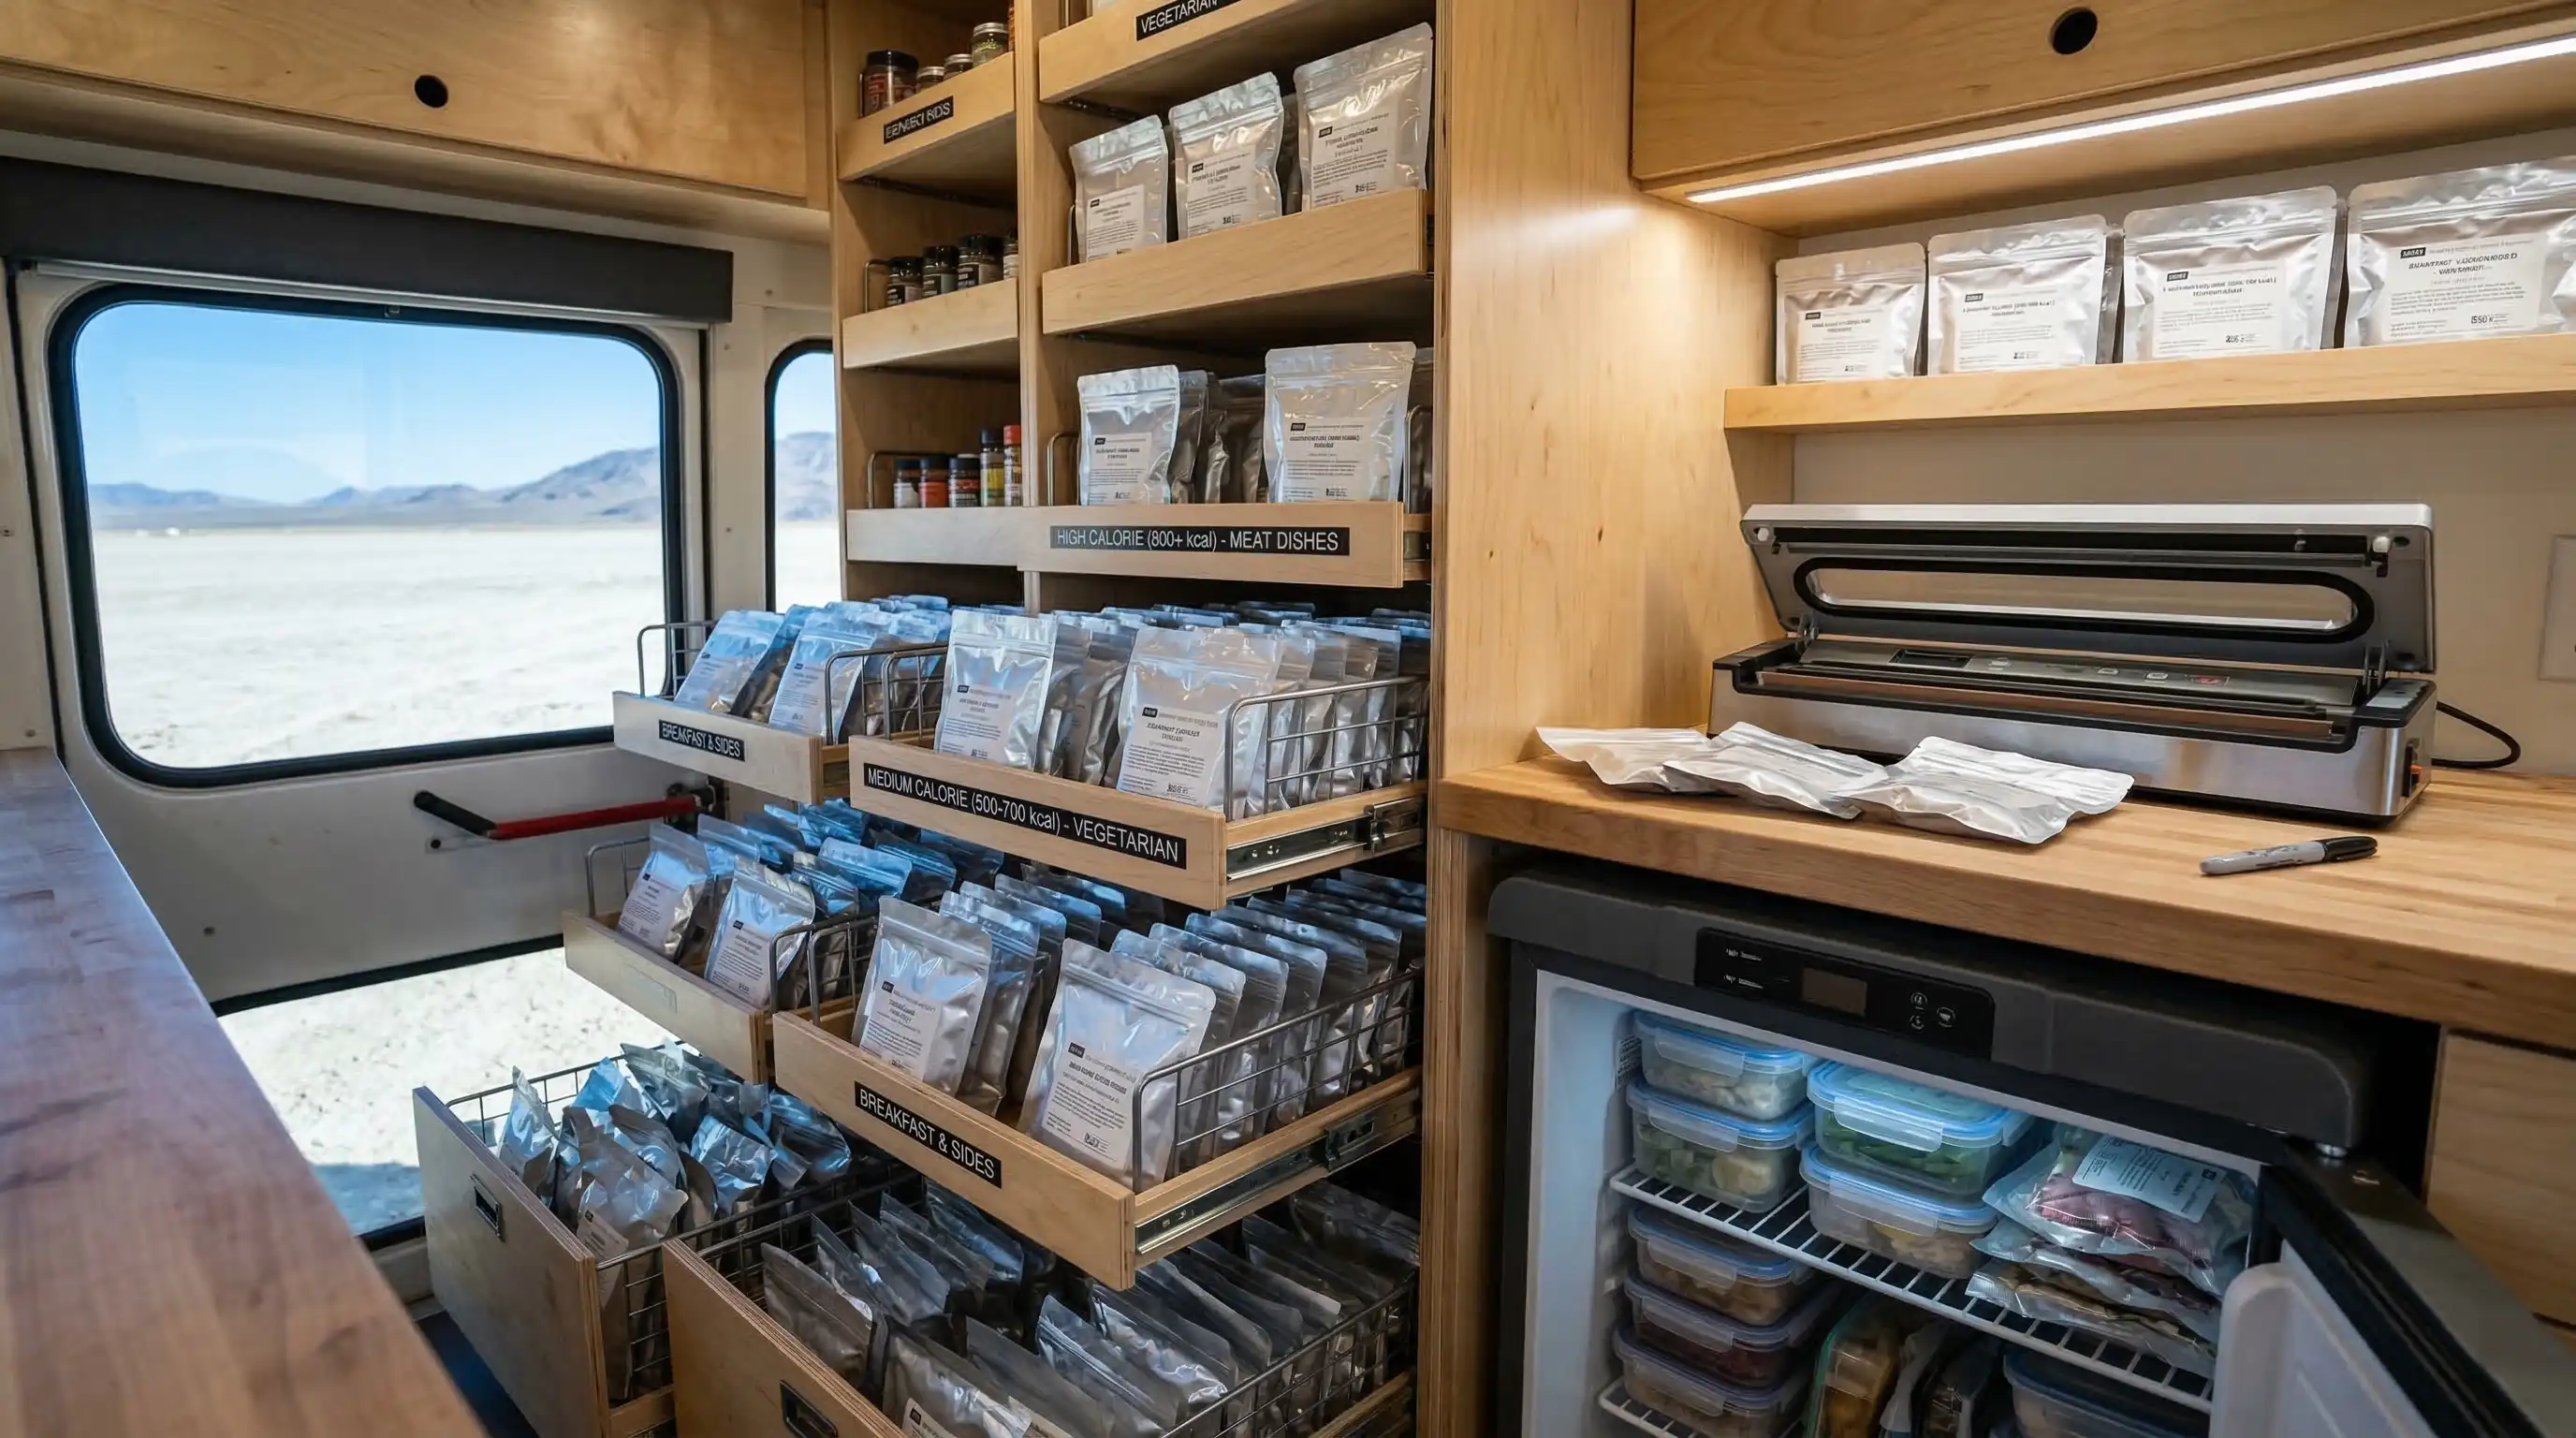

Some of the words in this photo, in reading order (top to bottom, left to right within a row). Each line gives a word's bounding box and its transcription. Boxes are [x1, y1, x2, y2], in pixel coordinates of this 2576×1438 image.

[1058, 530, 1086, 545] HIGH
[1090, 529, 1144, 546] CALORIE
[1148, 530, 1183, 550] (800+
[1187, 530, 1217, 551] kcal)
[1230, 531, 1272, 549] MEAT
[1277, 531, 1339, 550] DISHES
[715, 736, 740, 757] SIDES
[868, 768, 913, 794] MEDIUM
[915, 779, 968, 808] CALORIE
[972, 792, 1026, 823] (500-700
[1030, 806, 1061, 837] kcal)
[1073, 816, 1178, 862] VEGETARIAN
[860, 1088, 935, 1145] BREAKFAST
[938, 1132, 948, 1154] &
[951, 1139, 995, 1179] SIDES
